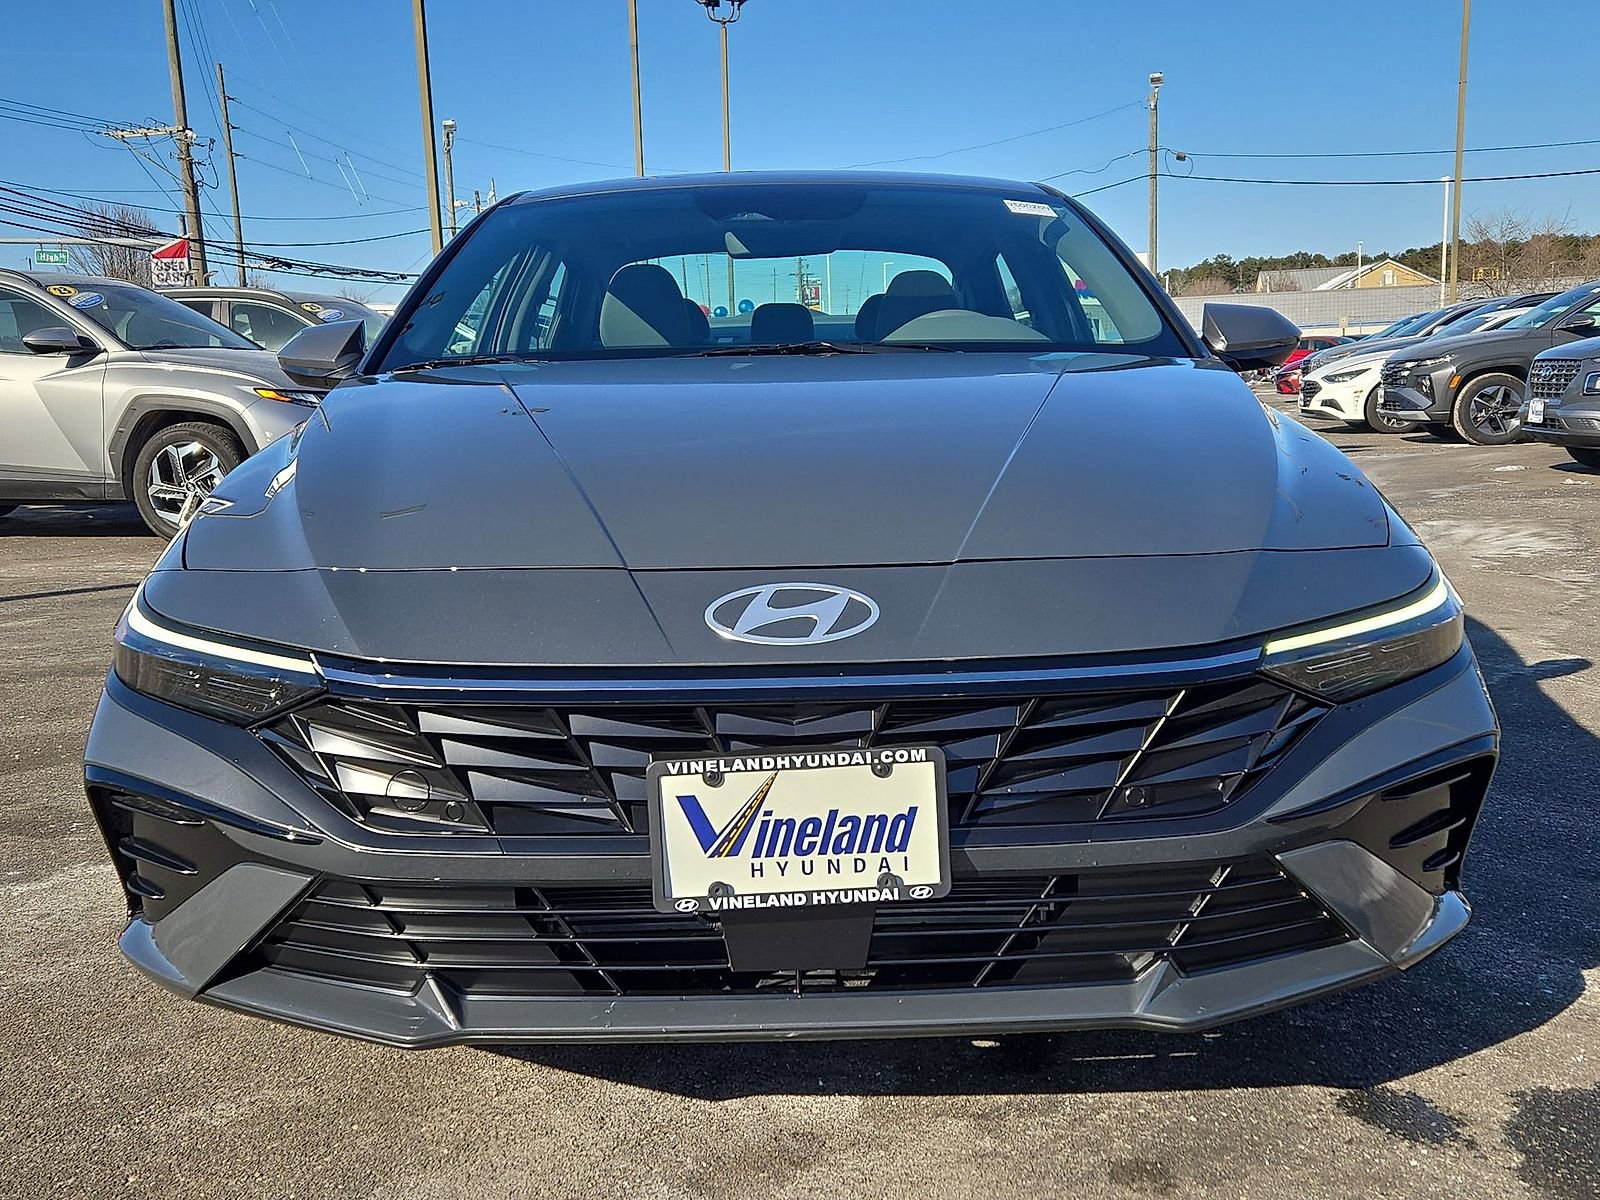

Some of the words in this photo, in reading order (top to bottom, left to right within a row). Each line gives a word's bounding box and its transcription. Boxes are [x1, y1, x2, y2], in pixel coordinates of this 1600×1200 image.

[155, 260, 184, 271] USED
[666, 748, 927, 775] VINELANDHYUNDAI.COM
[675, 770, 918, 859] Vineland
[751, 856, 909, 878] HYUNDAI
[708, 893, 807, 910] VINELAND
[812, 887, 899, 907] HYUNDAI
